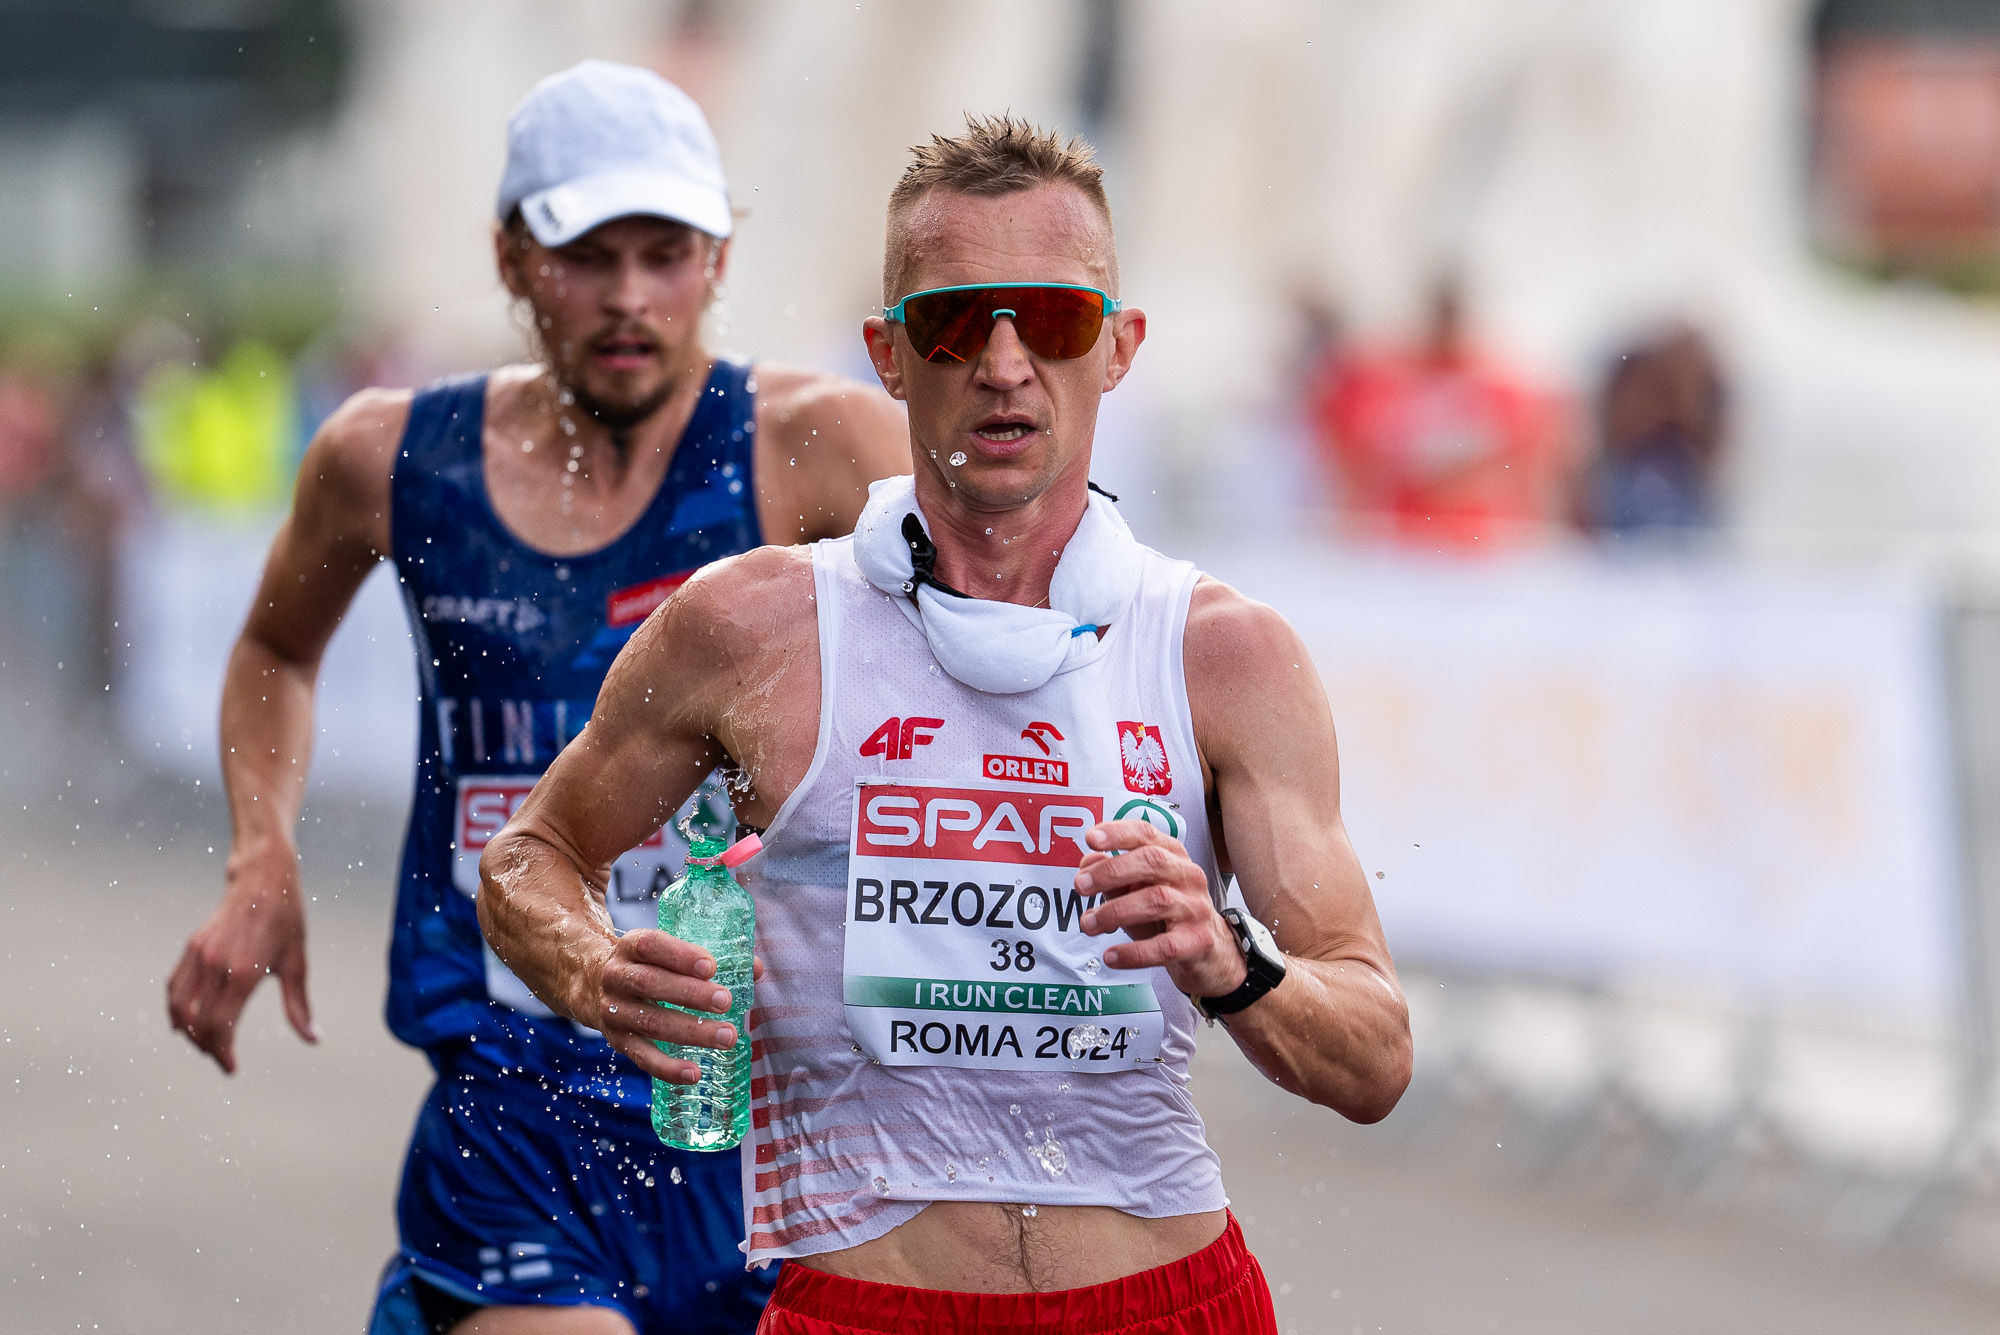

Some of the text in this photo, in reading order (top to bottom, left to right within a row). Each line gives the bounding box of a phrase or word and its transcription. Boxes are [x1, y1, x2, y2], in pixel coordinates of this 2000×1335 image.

[986, 757, 1064, 784] ORLEN
[865, 795, 1096, 856] SPAR
[854, 877, 1126, 935] BRZOZOW
[989, 939, 1036, 972] 38
[914, 982, 922, 1005] I
[930, 983, 996, 1009] RUN
[890, 1020, 1129, 1061] ROMA 2024
